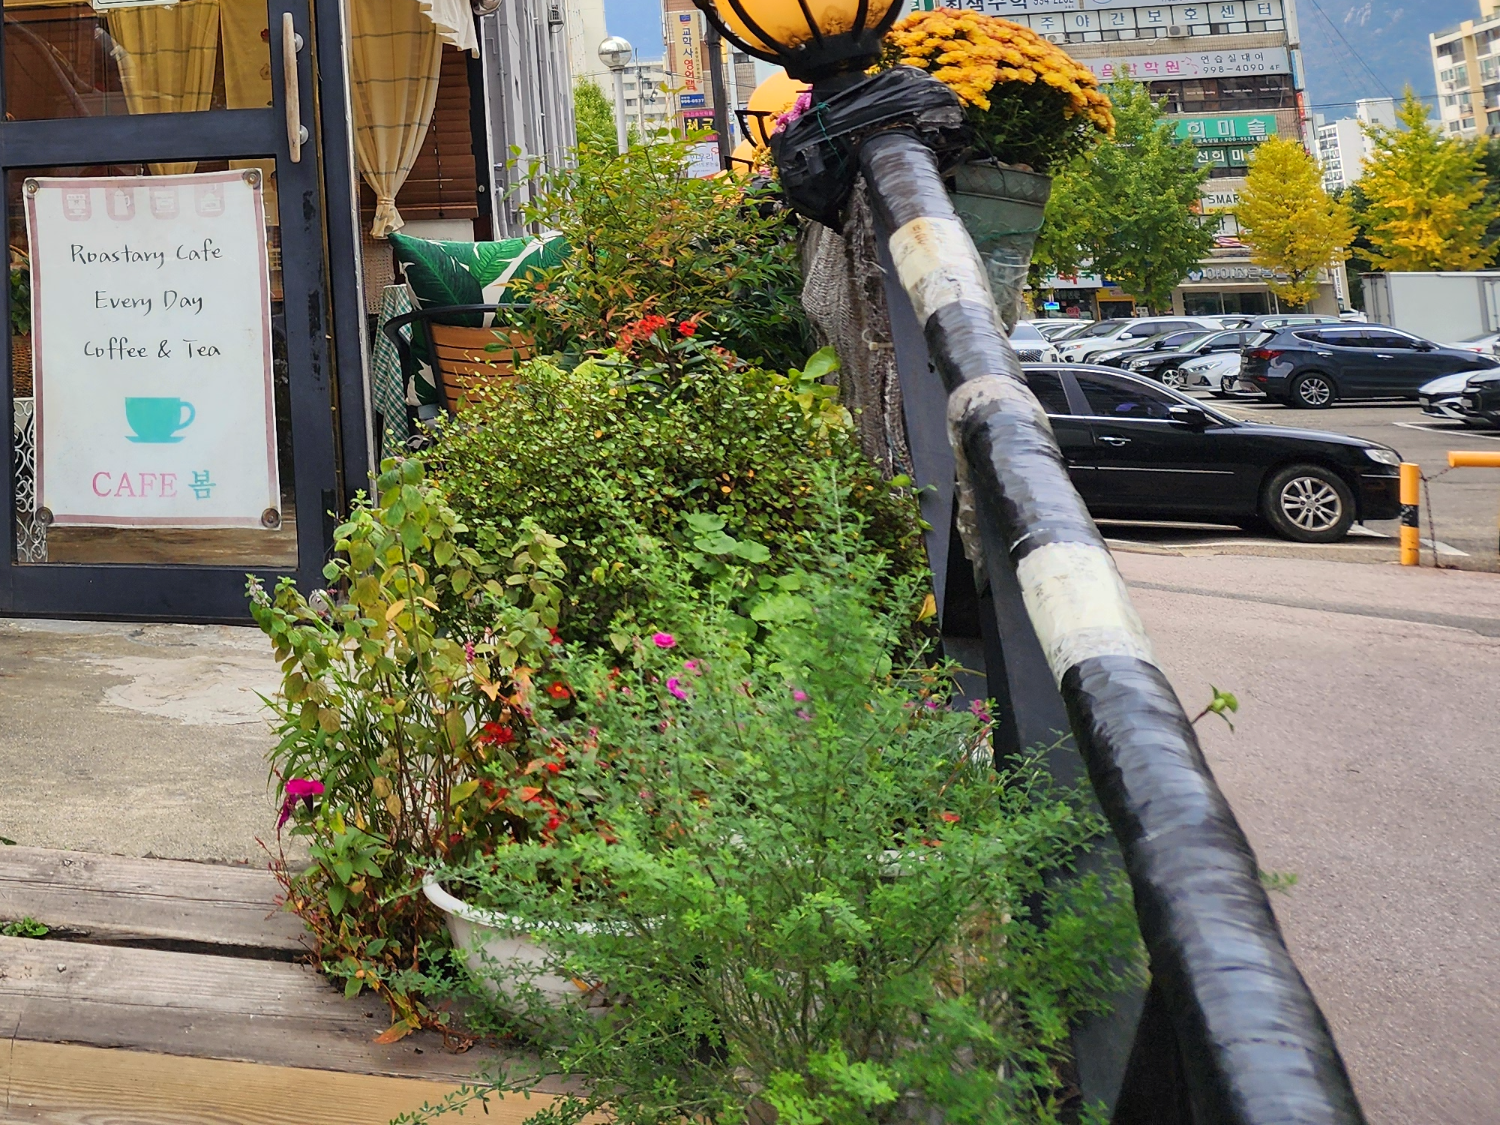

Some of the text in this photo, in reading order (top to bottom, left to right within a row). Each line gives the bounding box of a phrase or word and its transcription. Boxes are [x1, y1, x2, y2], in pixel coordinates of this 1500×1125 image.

[1202, 63, 1265, 74] 998-4090
[1173, 118, 1267, 138] 희미술
[1208, 194, 1240, 205] SMAR
[70, 238, 223, 270] Roastary Cafe
[94, 290, 203, 316] Every Day
[83, 337, 222, 359] Coffee & Tea
[91, 469, 217, 501] CAFE 봄
